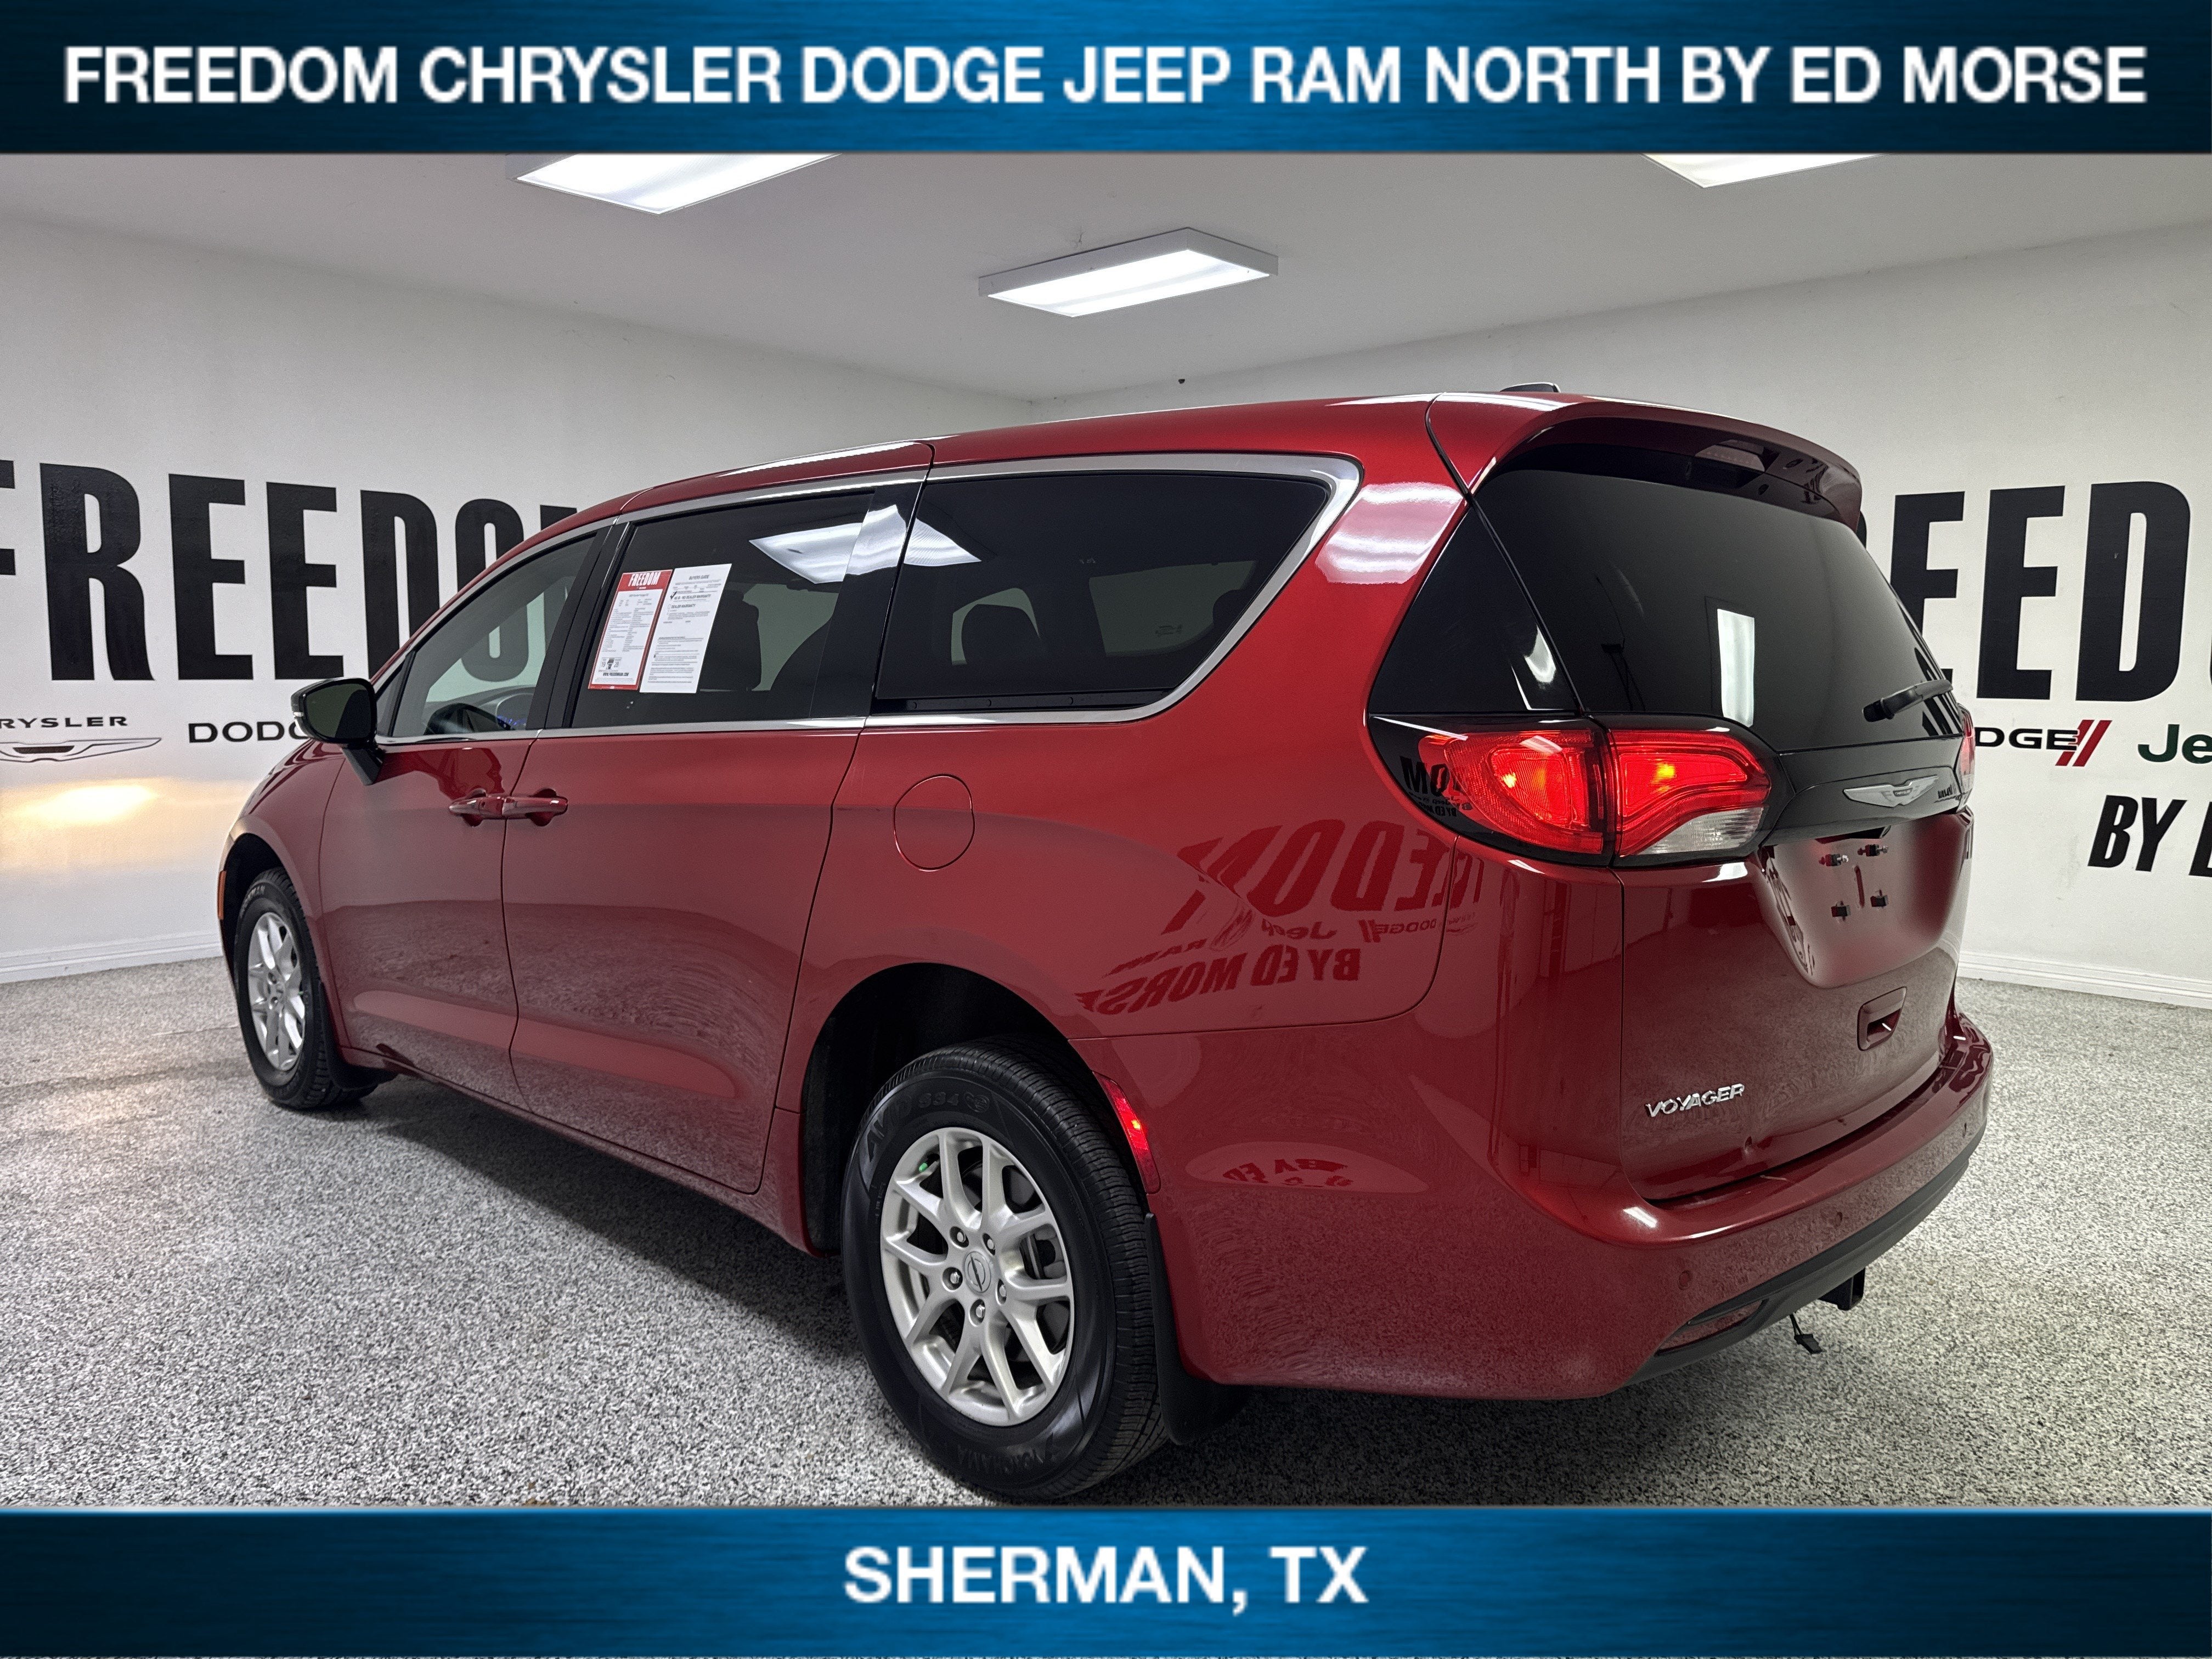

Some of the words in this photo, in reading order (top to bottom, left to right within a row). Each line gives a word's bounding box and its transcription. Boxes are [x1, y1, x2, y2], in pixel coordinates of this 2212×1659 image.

[0, 460, 578, 682] REEDO
[628, 571, 662, 587] FREEDOM
[0, 716, 128, 729] RYSLER
[1974, 727, 2079, 751] DGE
[2137, 724, 2212, 764] Je
[2087, 794, 2188, 872] BY
[1646, 1083, 1745, 1118] VOYAGER
